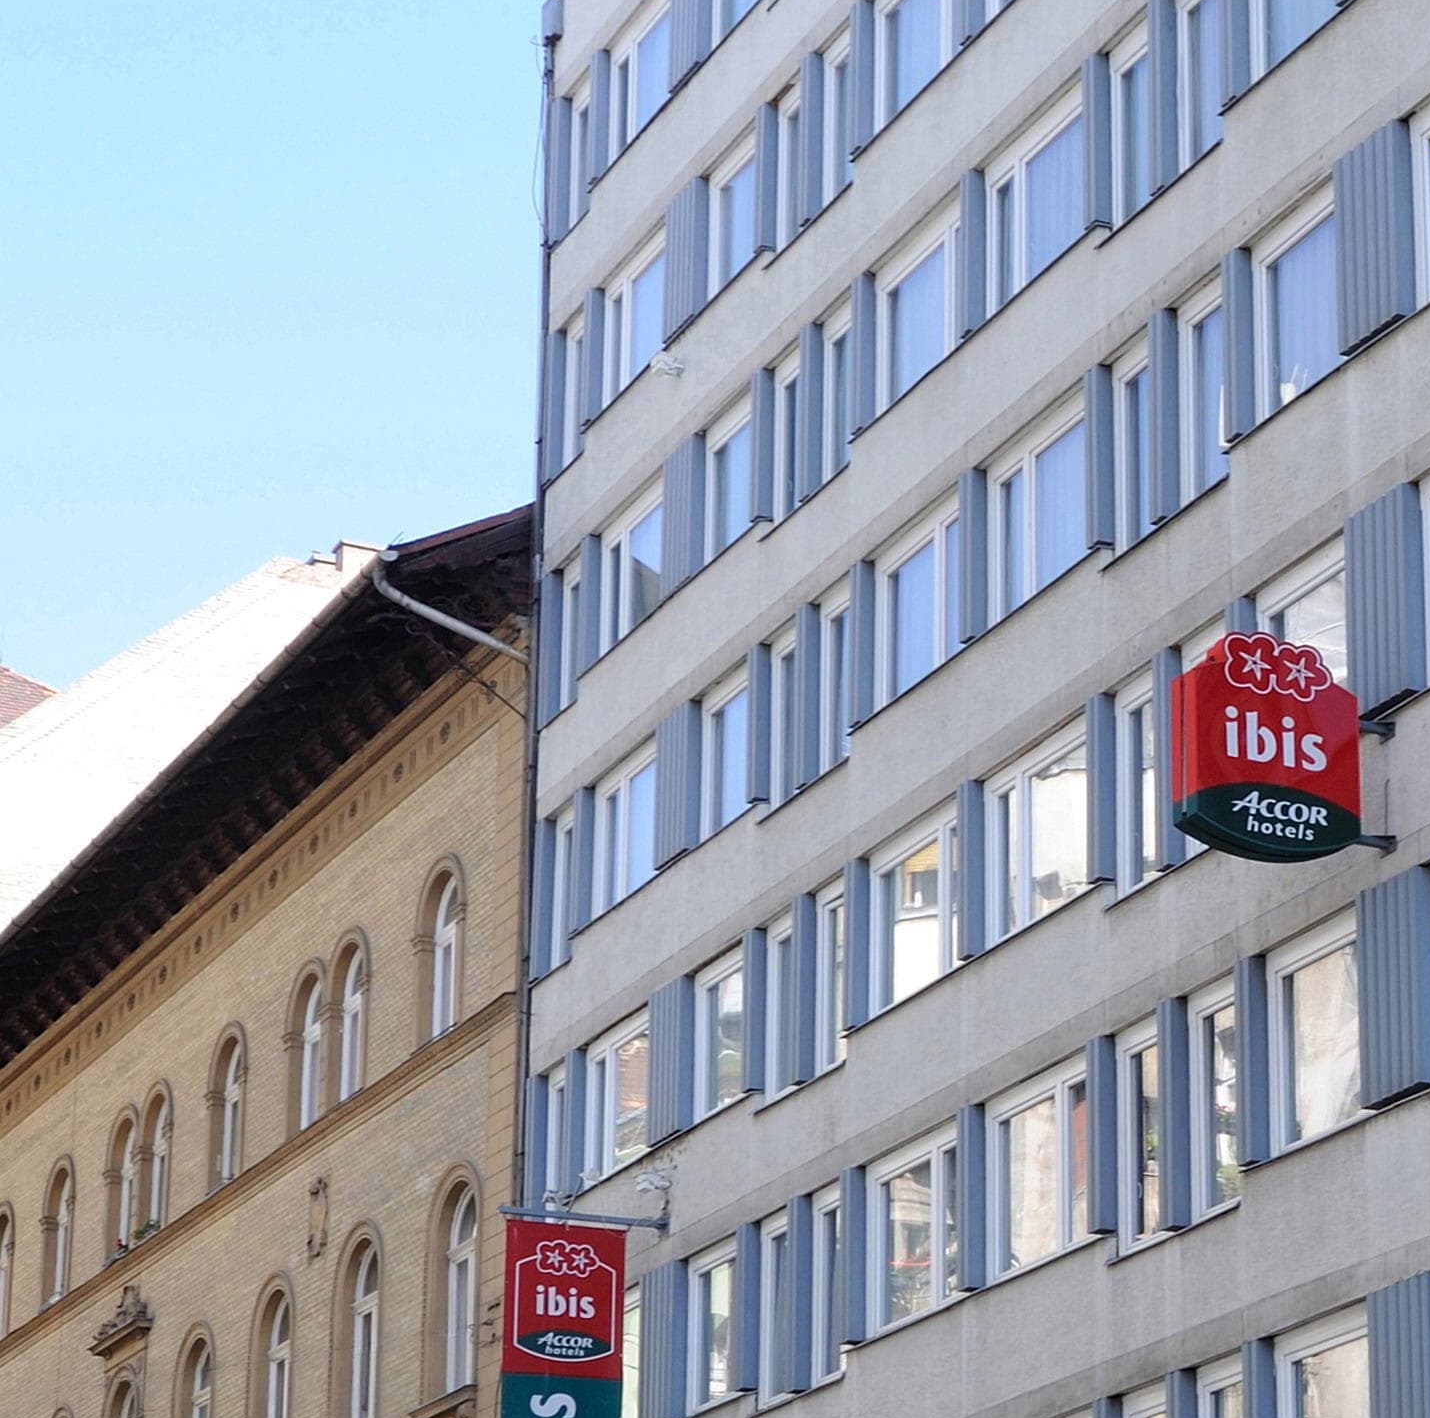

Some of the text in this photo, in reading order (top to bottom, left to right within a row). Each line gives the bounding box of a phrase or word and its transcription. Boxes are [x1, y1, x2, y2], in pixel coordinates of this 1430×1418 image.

[1224, 705, 1328, 772] ibis
[1231, 790, 1329, 827] ACCOR
[1246, 815, 1315, 841] hotels
[535, 1284, 596, 1319] ibis
[537, 1332, 593, 1349] ACCOR
[544, 1345, 585, 1357] hotels
